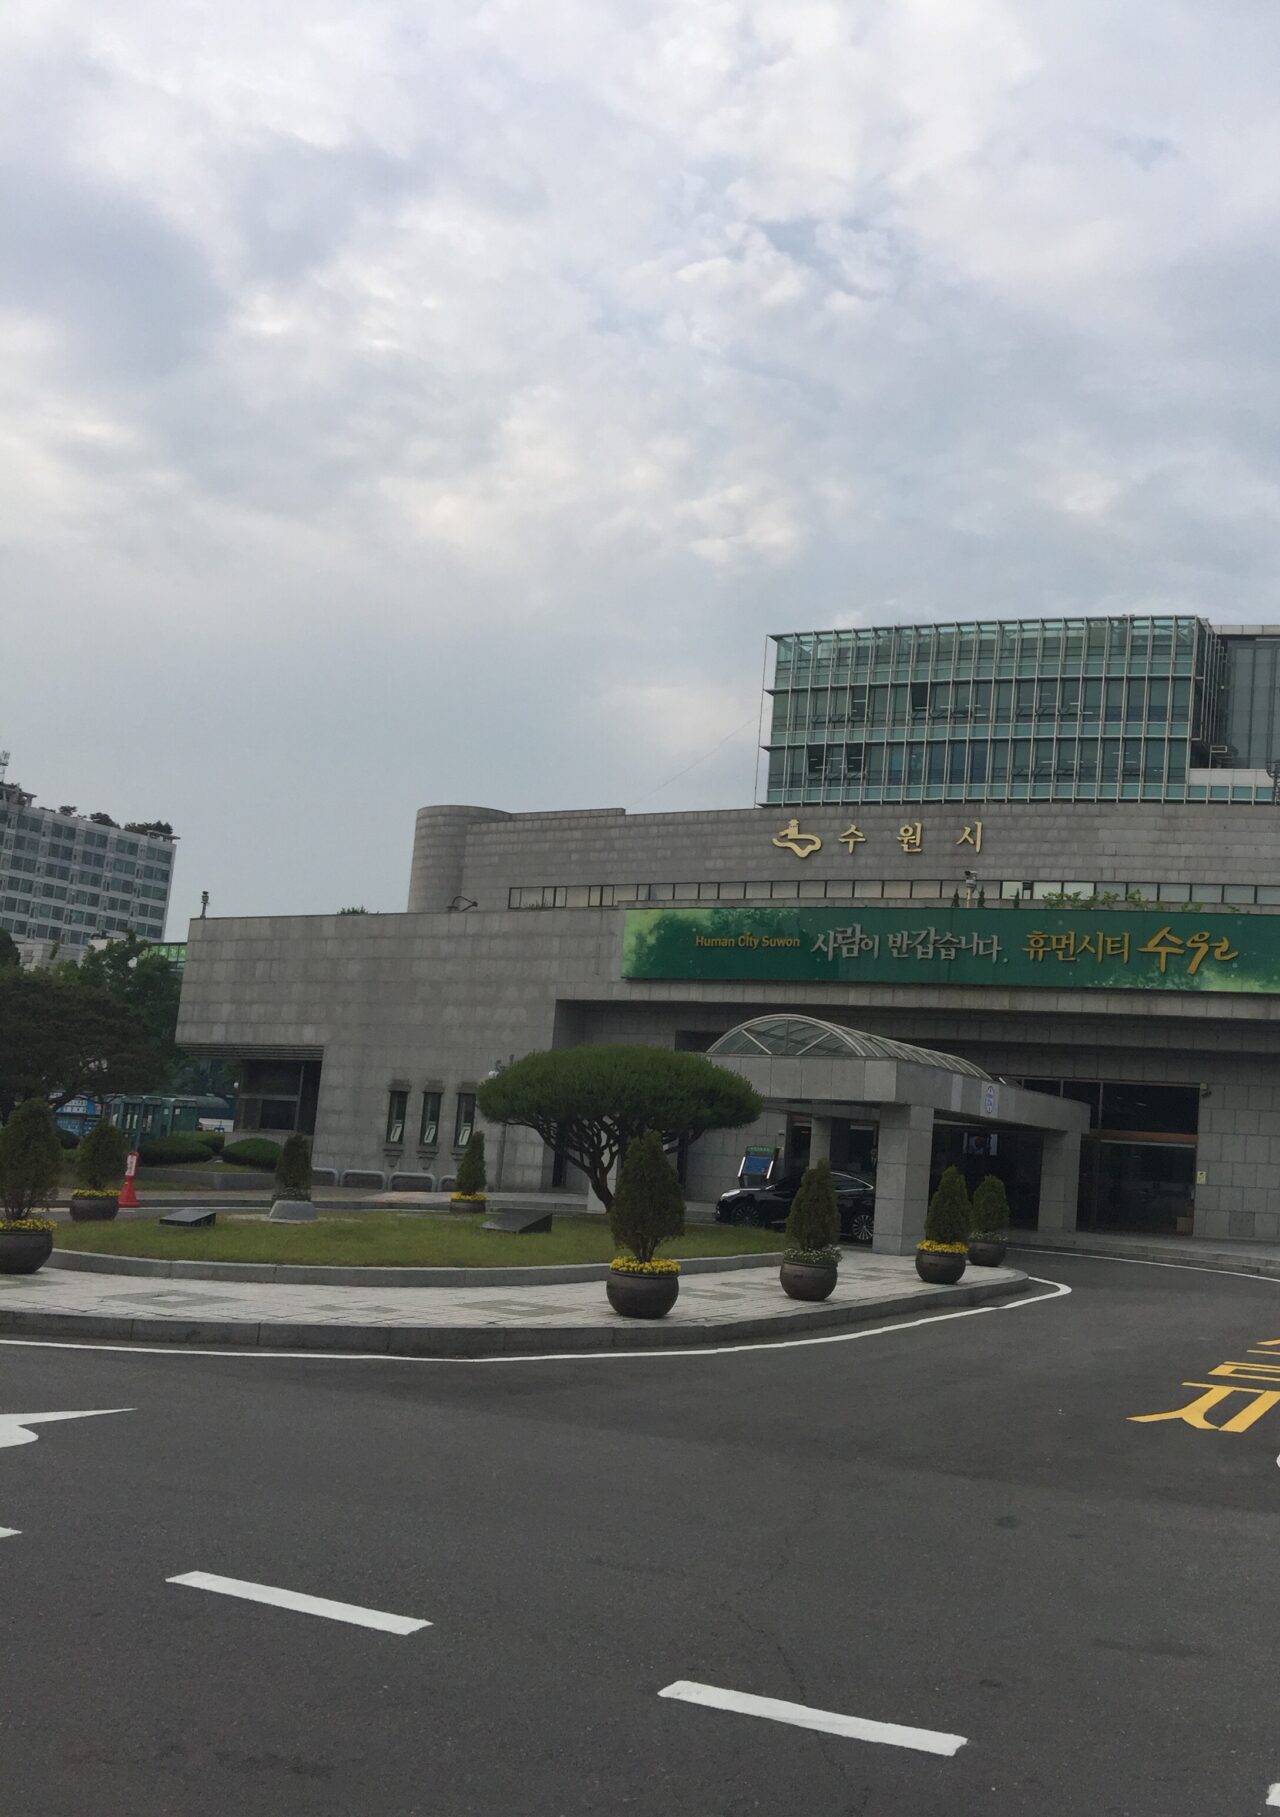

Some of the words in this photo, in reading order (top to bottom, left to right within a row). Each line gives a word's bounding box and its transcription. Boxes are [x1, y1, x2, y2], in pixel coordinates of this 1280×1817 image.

[838, 821, 982, 854] 수원시
[695, 935, 735, 947] Human
[737, 934, 759, 950] City
[761, 936, 801, 948] Suwon
[811, 924, 880, 961] 사람이
[887, 926, 1009, 964] 반갑습니다.
[1022, 930, 1130, 964] 휴먼시티
[1137, 926, 1239, 976] 수원
